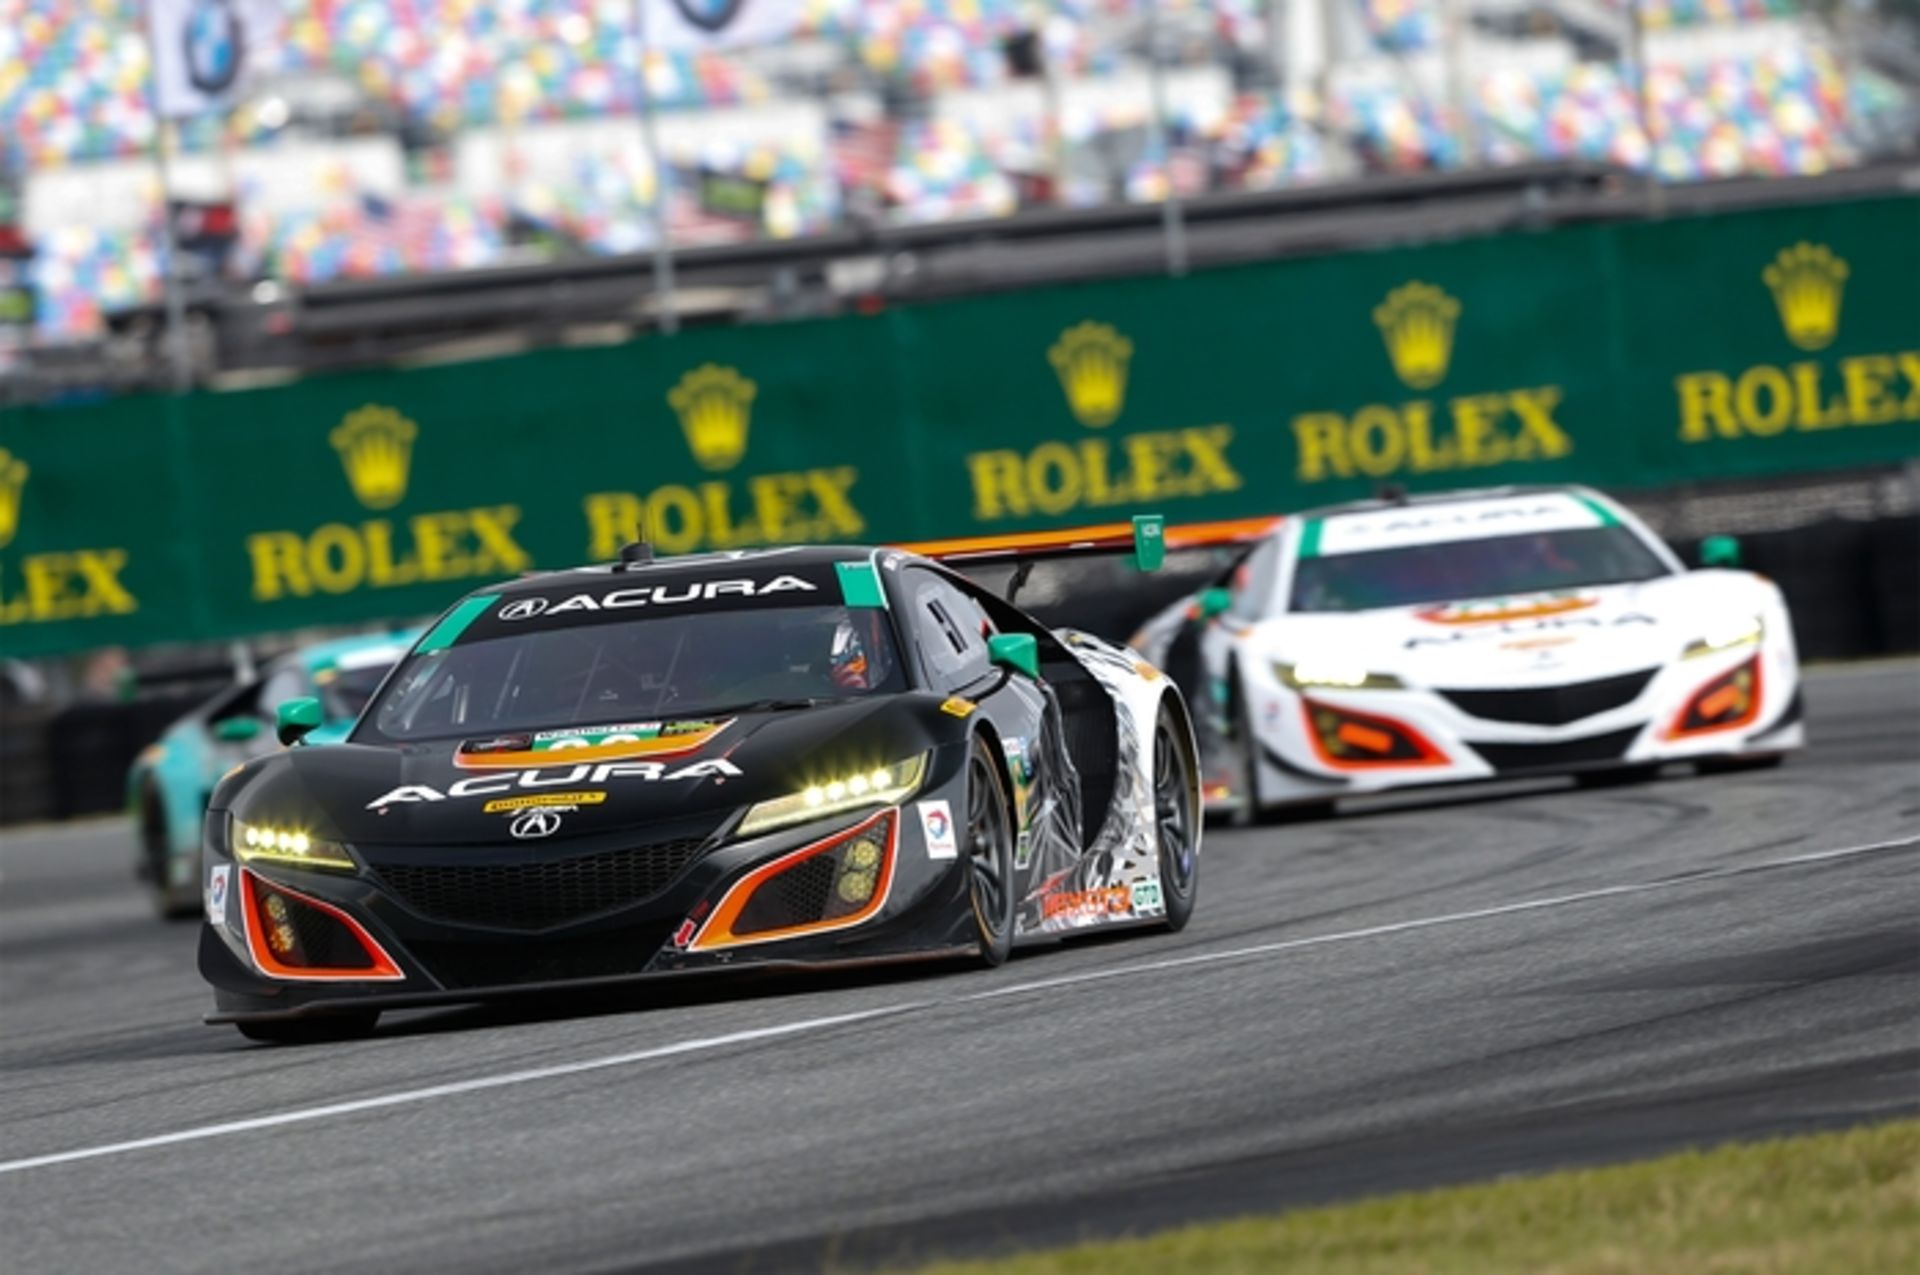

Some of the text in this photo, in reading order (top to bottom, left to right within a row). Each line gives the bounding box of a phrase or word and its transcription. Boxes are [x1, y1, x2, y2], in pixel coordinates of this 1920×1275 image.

[968, 426, 1241, 520] ROLEX
[1293, 387, 1571, 481] ROLEX
[247, 505, 530, 600] ROLEX
[584, 467, 864, 562] ROLEX
[545, 575, 817, 615] ACURA
[366, 758, 744, 810] ACURA
